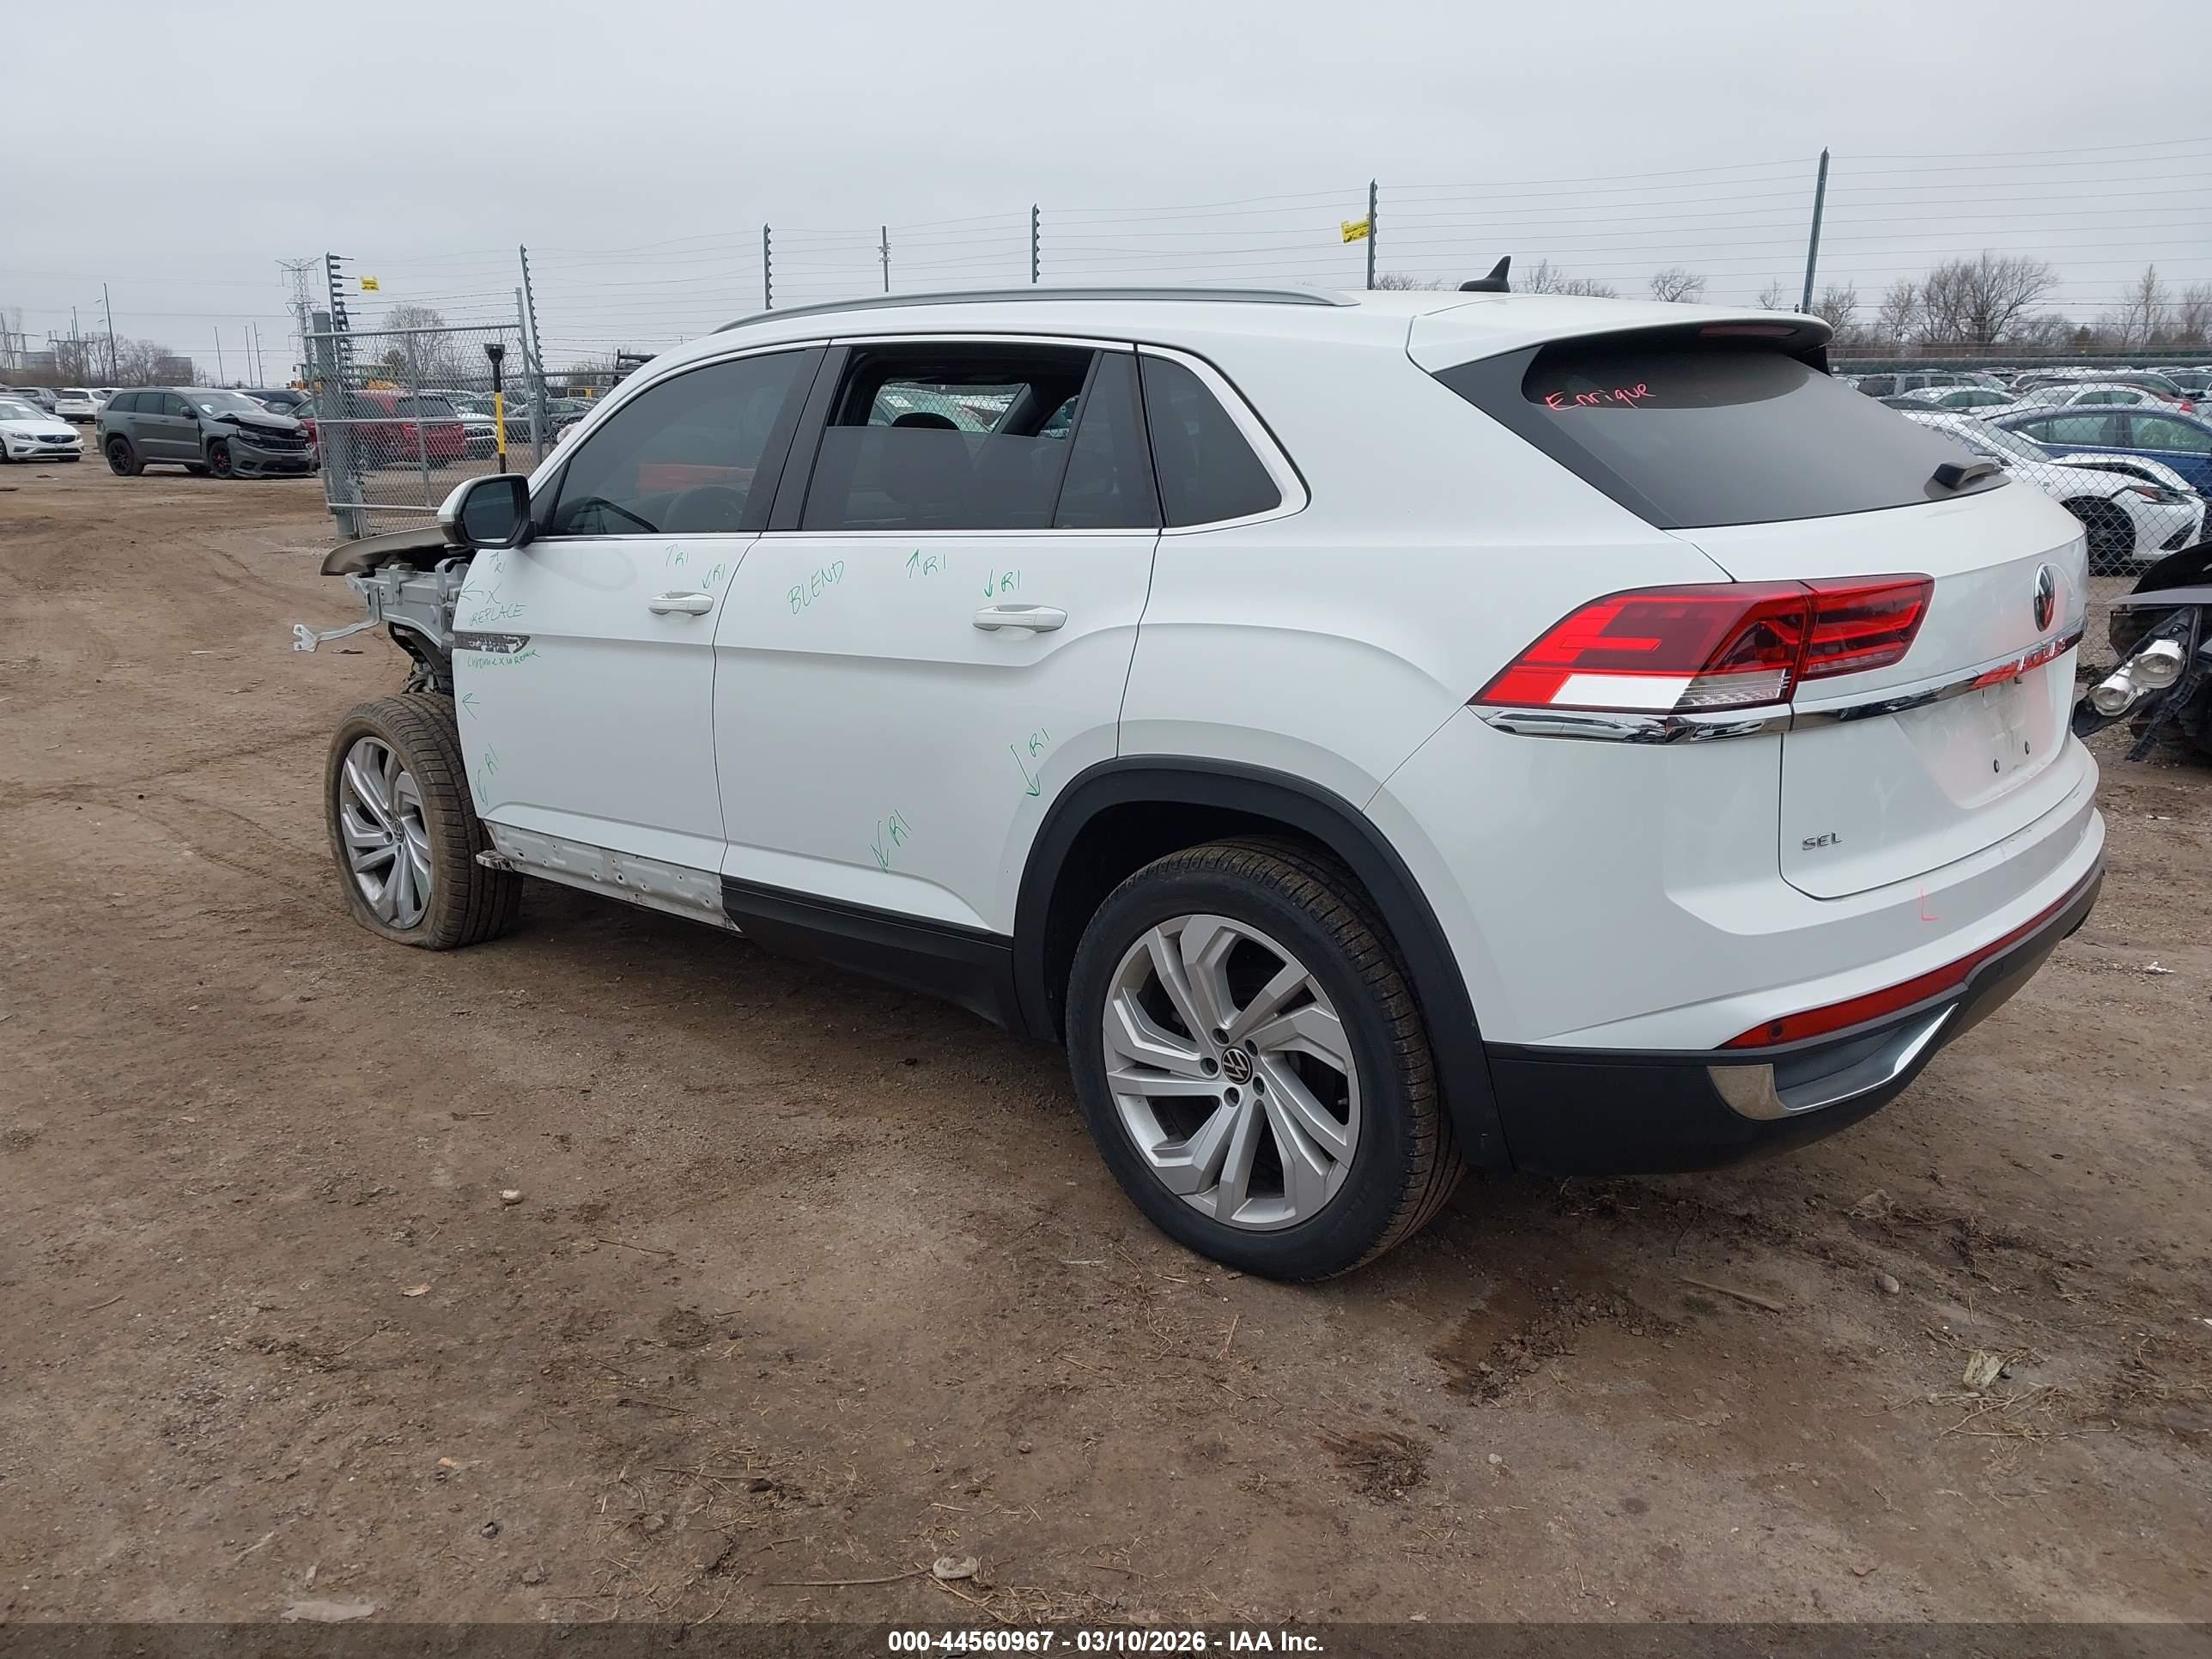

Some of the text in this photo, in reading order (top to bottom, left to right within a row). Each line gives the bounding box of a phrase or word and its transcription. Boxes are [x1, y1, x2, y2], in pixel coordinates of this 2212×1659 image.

[1546, 383, 1657, 410] Enrique
[787, 561, 845, 615] BLEND
[469, 604, 526, 626] REPLACE
[1802, 831, 1843, 851] SEL
